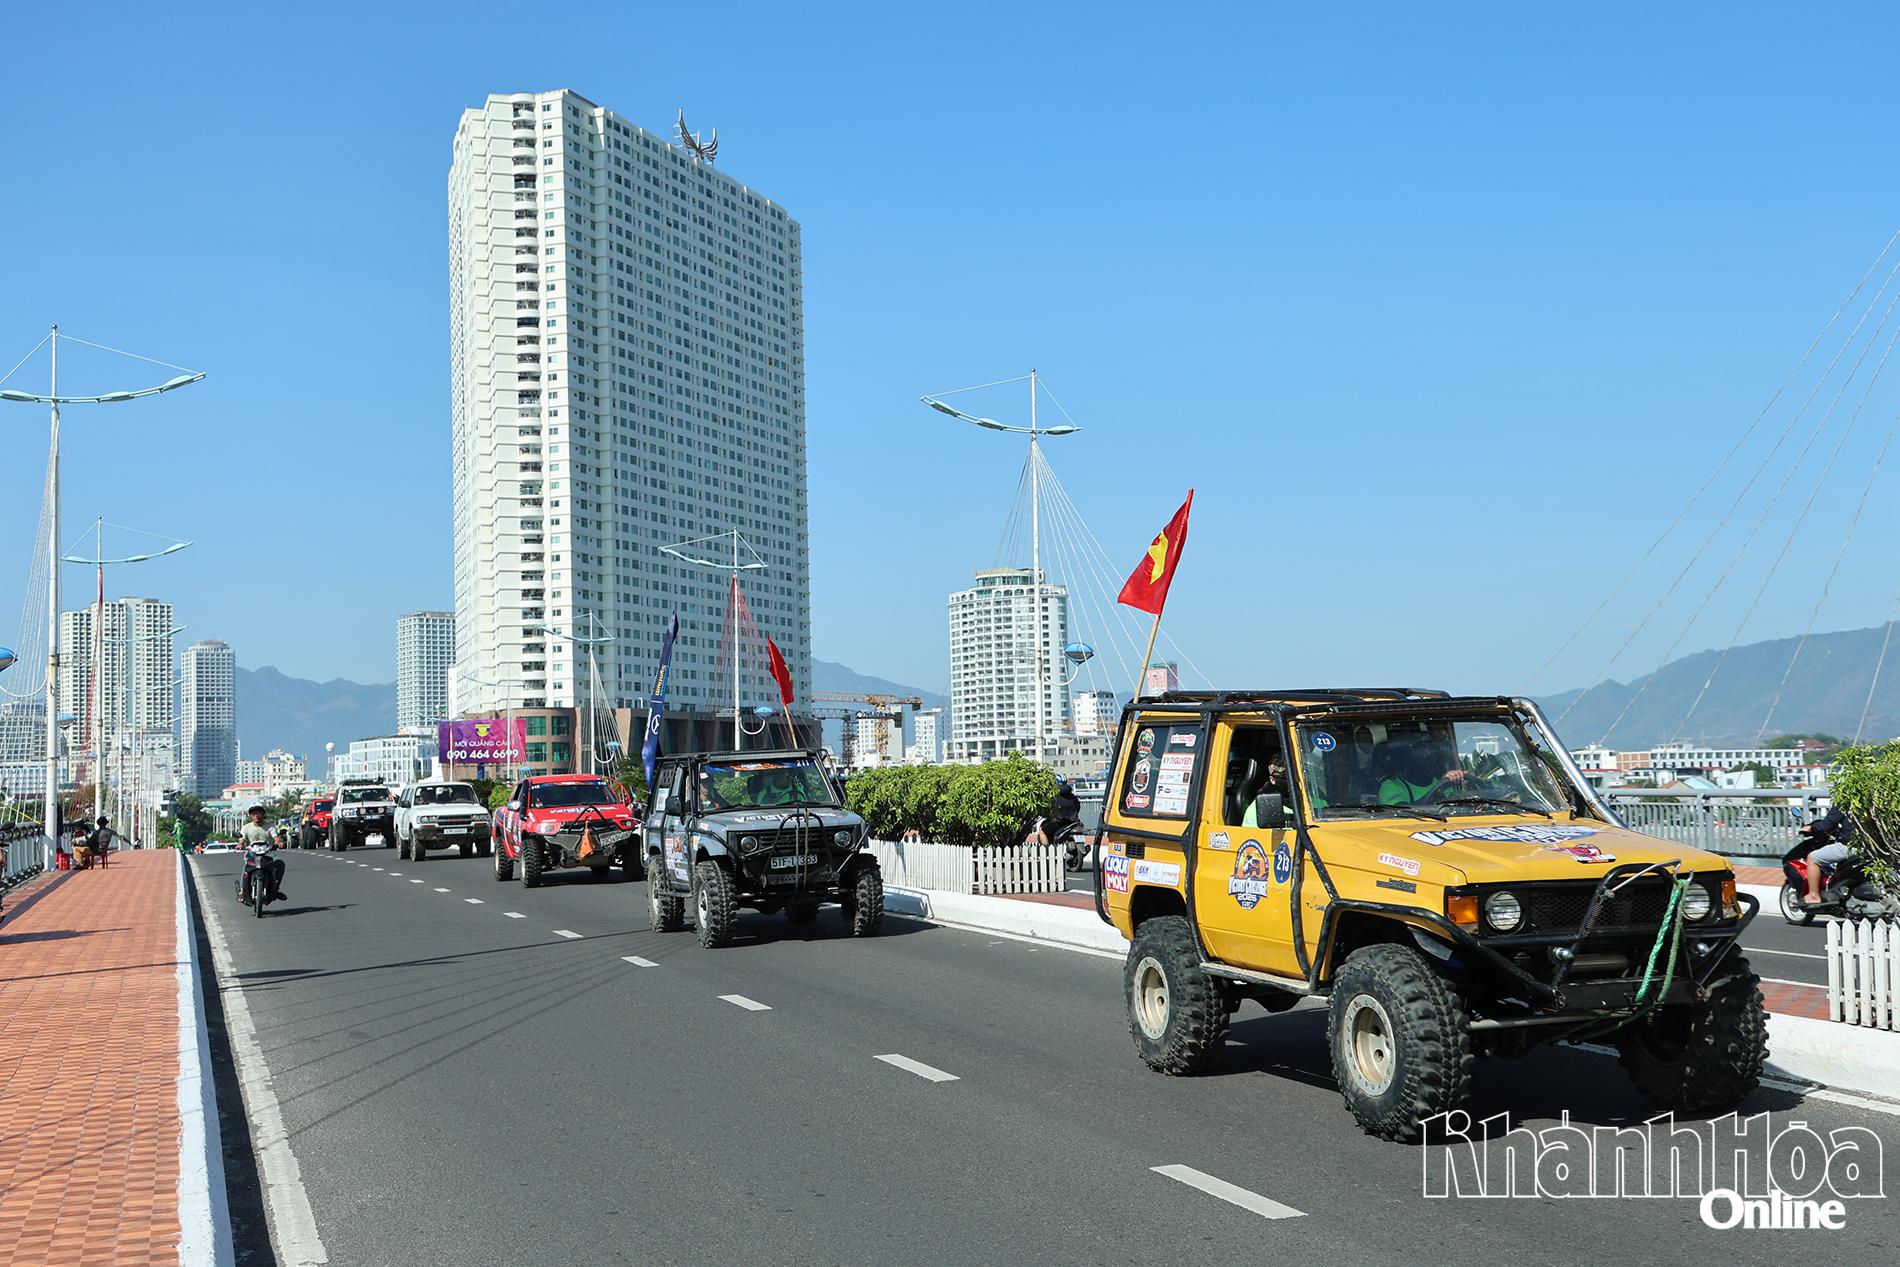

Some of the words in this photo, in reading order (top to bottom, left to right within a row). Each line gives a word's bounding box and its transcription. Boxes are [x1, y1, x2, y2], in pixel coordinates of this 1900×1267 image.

[1316, 737, 1331, 746] 213
[469, 750, 490, 759] 464
[1106, 855, 1128, 875] LIQUI
[1276, 852, 1289, 873] 213
[1107, 873, 1128, 893] MOLY
